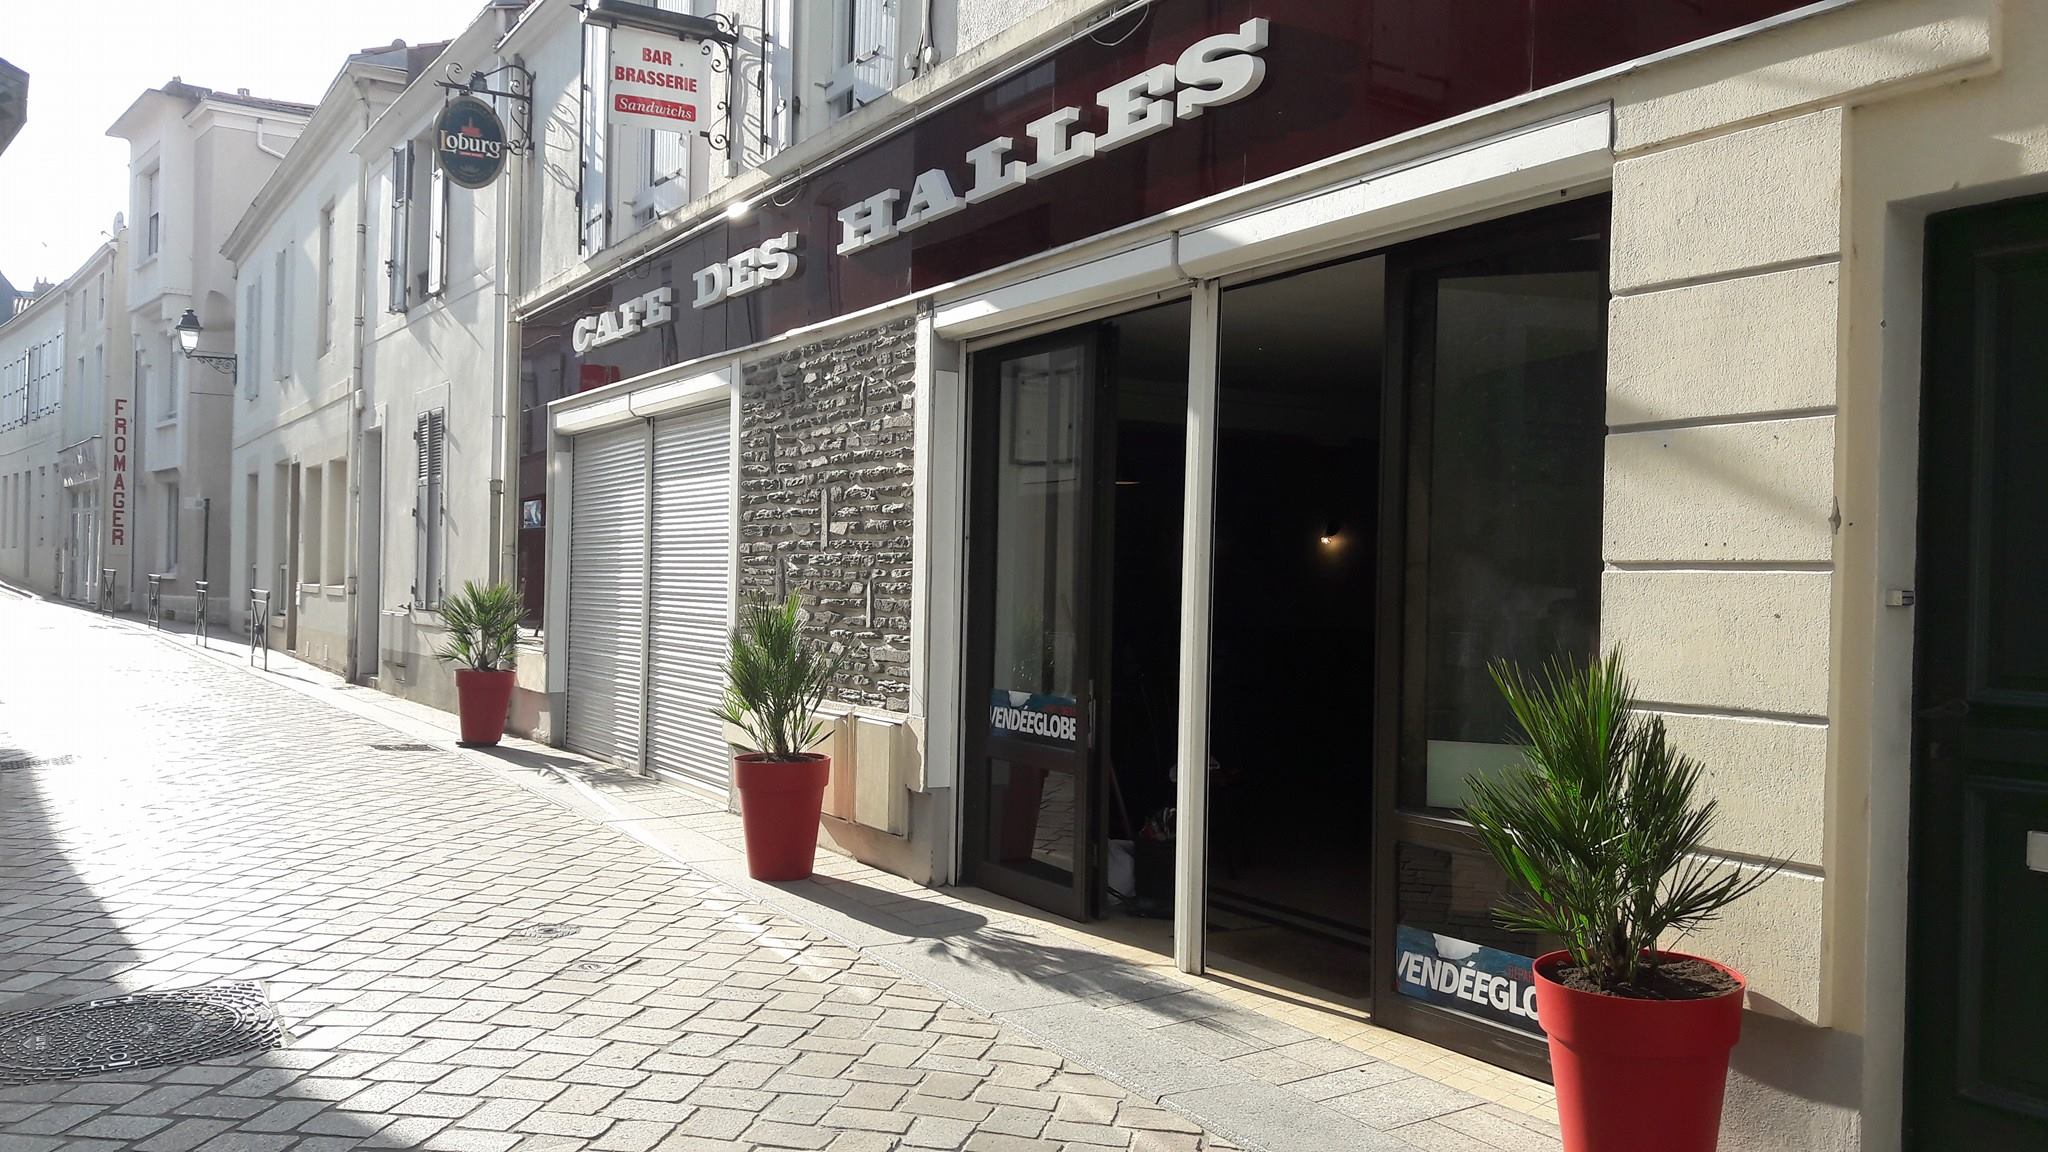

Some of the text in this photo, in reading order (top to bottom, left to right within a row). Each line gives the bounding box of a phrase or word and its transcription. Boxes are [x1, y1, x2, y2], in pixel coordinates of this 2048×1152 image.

[642, 47, 672, 66] BAR
[614, 66, 697, 93] BRASSERIE
[618, 97, 692, 120] Sandwichs
[439, 129, 502, 158] Loburg
[572, 16, 1271, 353] CAFE DES HALLES
[111, 398, 127, 546] FROMAGER
[990, 704, 1077, 741] VENDÉEGLOBE
[1397, 950, 1540, 1021] VENDÉEGLO
